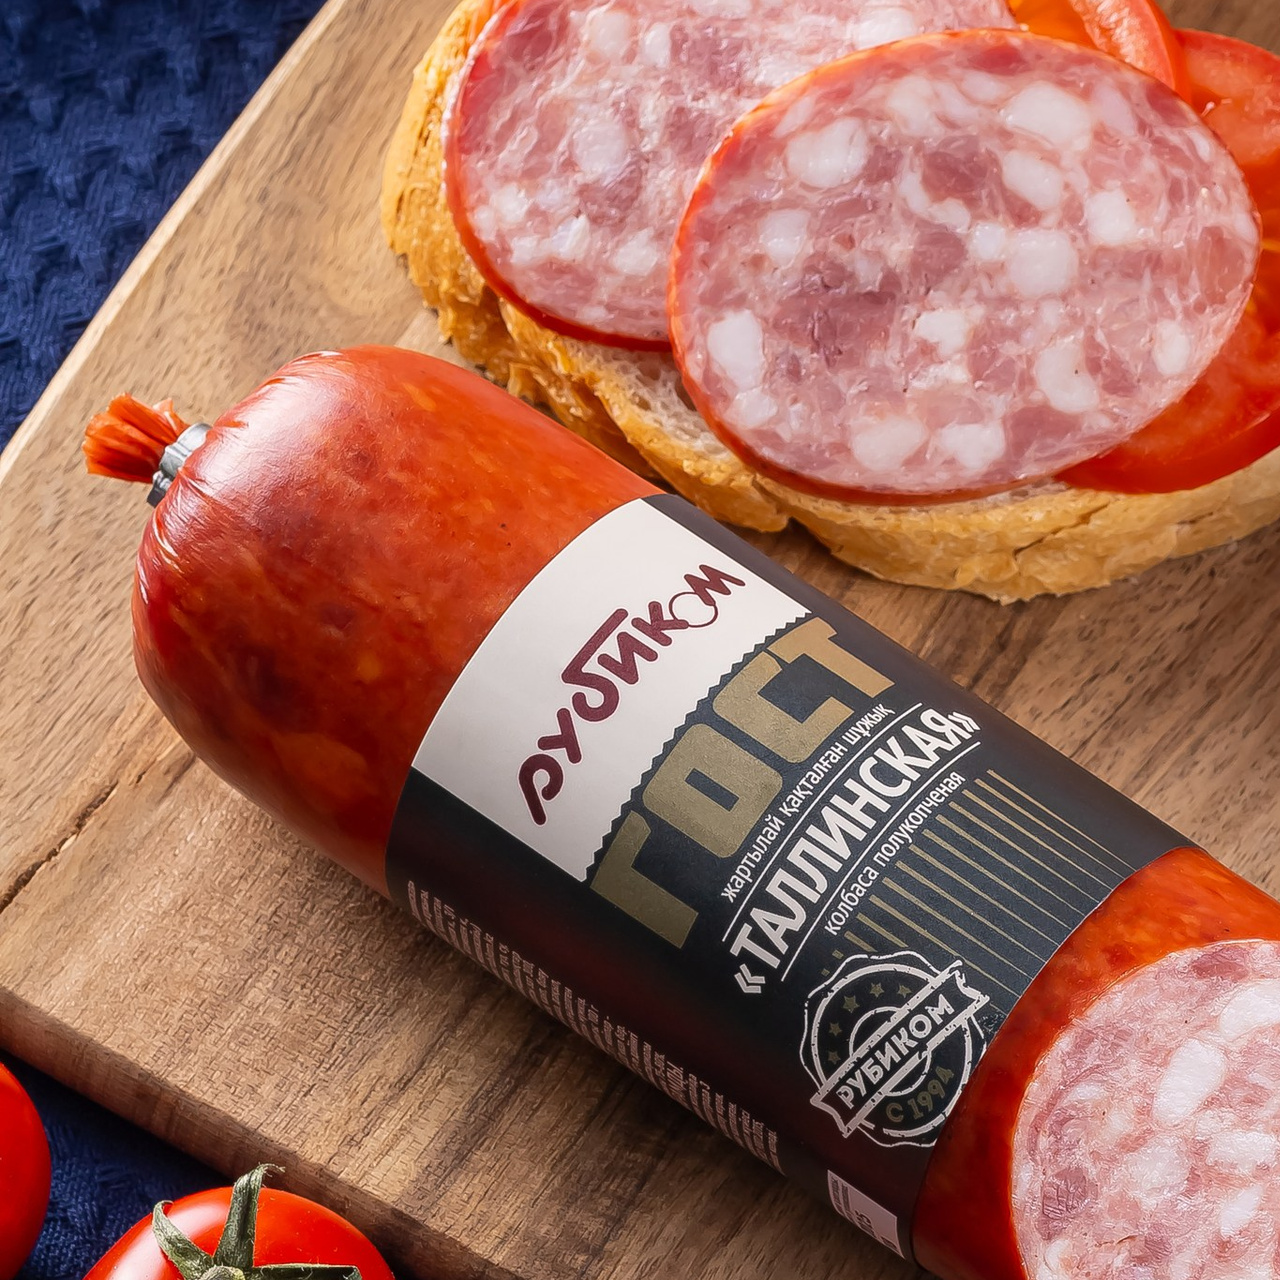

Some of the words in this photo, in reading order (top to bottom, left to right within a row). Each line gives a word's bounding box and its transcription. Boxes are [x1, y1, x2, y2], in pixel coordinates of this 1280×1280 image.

[590, 617, 895, 949] ГОСТ
[721, 814, 786, 903] жартылай
[778, 742, 849, 818] қақталған
[729, 708, 981, 995] «ТАЛЛИНСКАЯ»
[824, 865, 880, 936] колбаса
[873, 771, 966, 868] полукопченая
[835, 993, 956, 1110] РУБИКОМ
[907, 1065, 955, 1120] 1994
